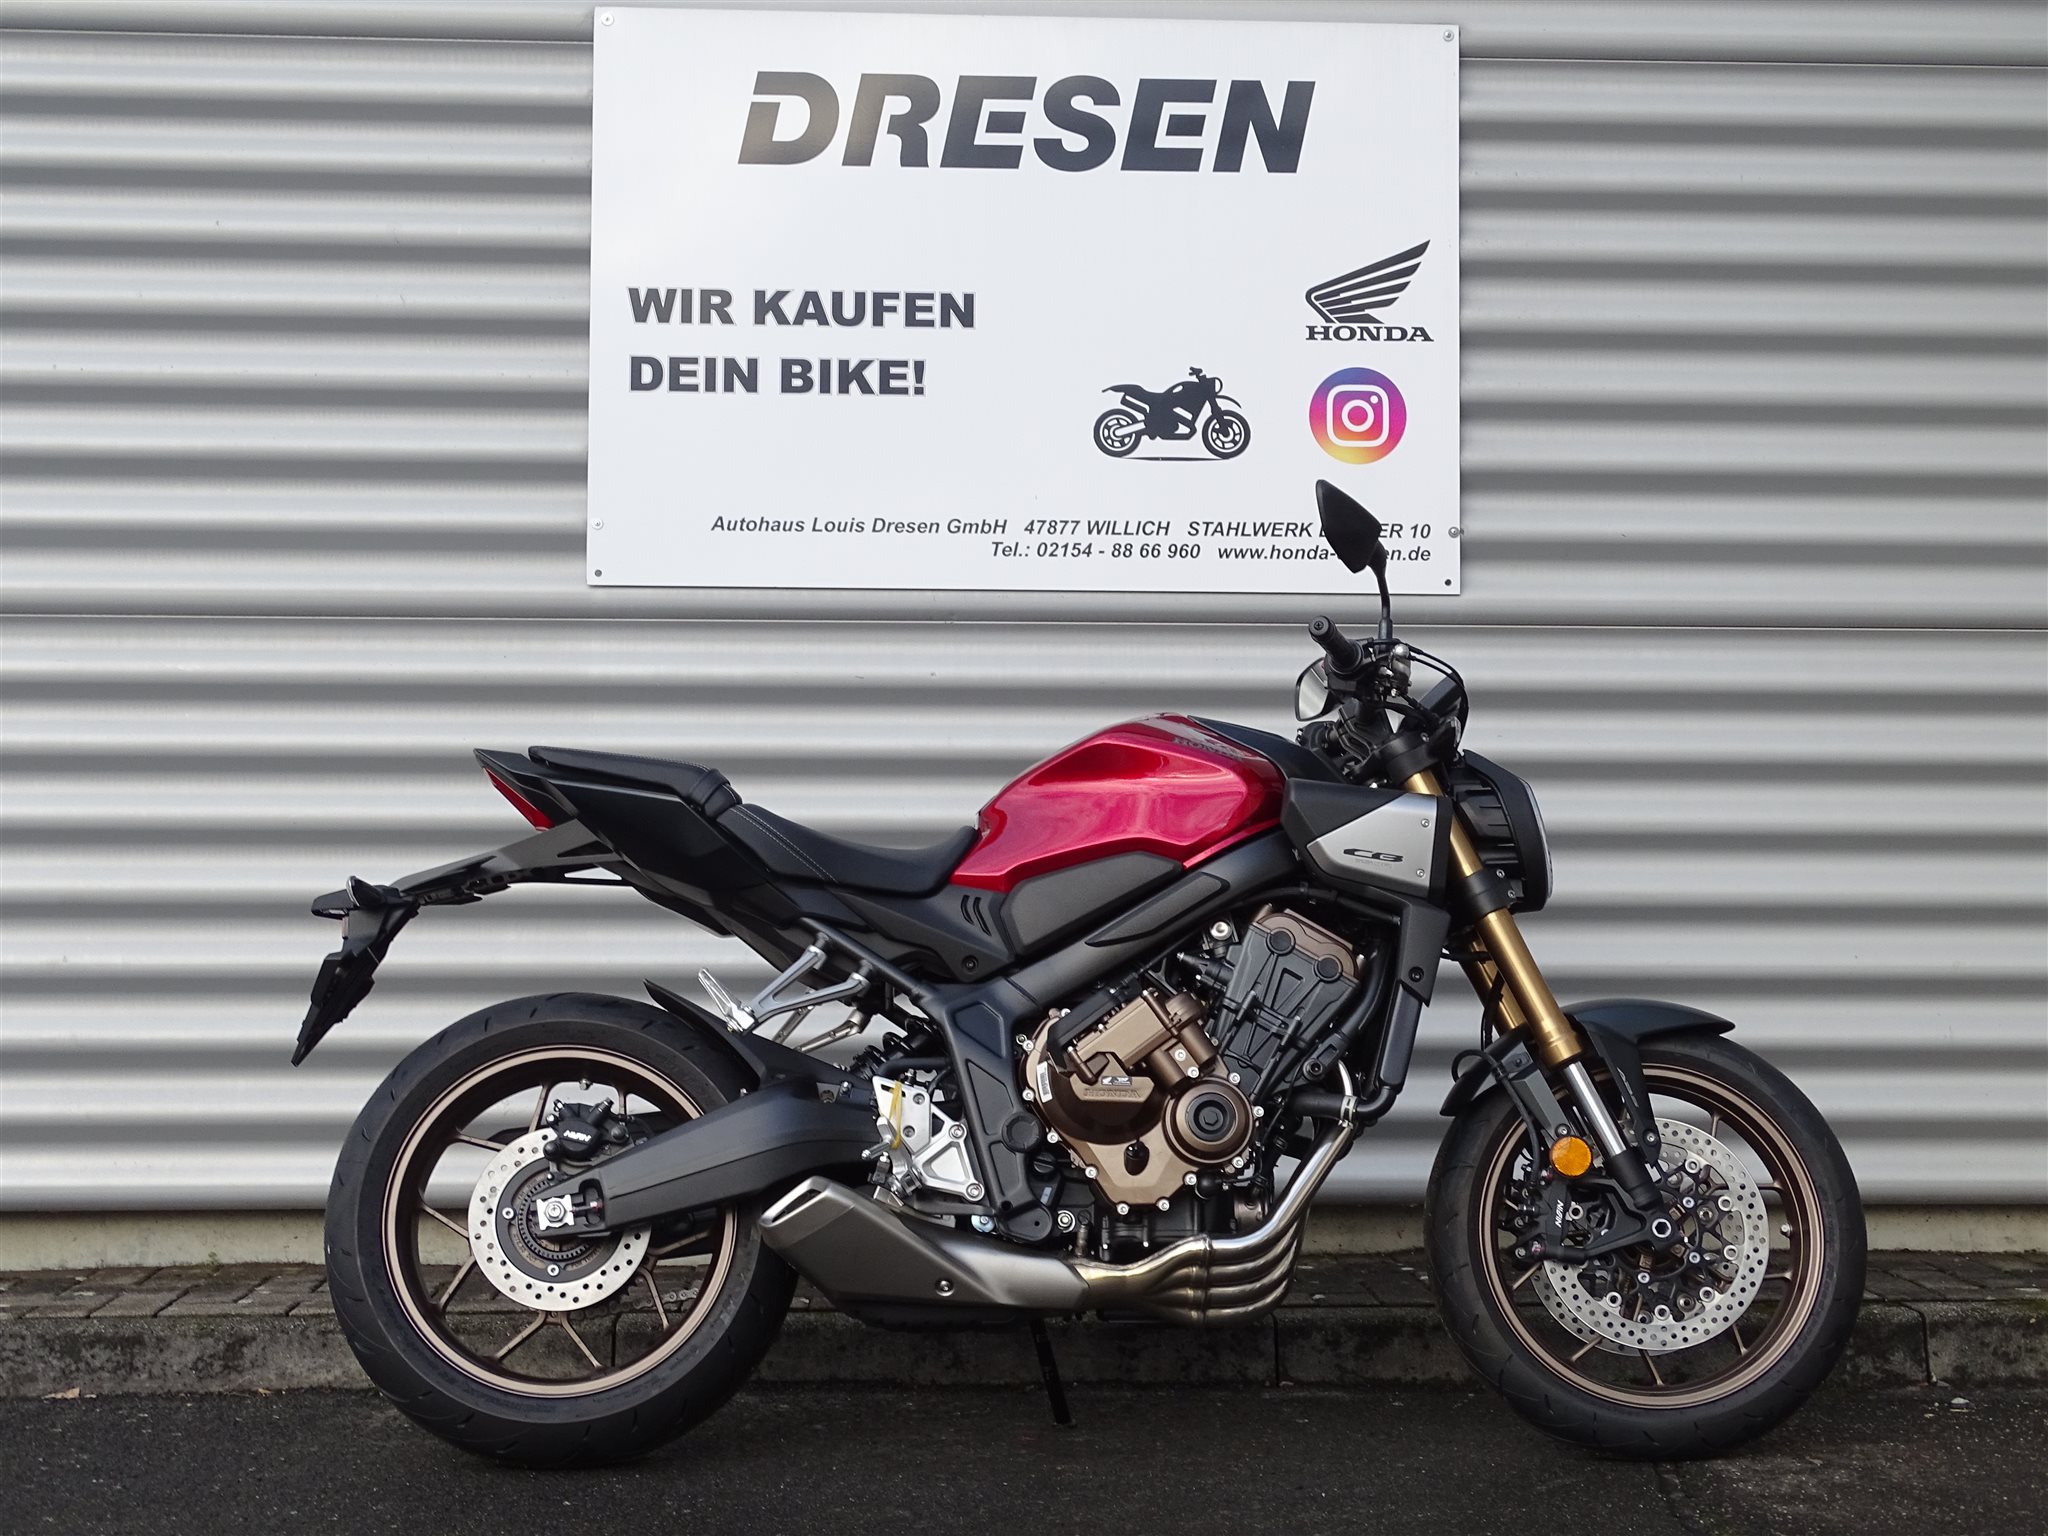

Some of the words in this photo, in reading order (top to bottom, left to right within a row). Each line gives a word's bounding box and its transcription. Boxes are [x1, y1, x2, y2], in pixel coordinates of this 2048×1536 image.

[738, 71, 1316, 174] DRESEN
[628, 287, 735, 325] WIR
[754, 290, 976, 329] KAUFEN
[1306, 324, 1434, 342] HONDA
[630, 356, 758, 393] DEIN
[780, 358, 926, 396] BIKE!
[710, 516, 805, 533] Autohaus
[811, 517, 865, 533] Louis
[871, 517, 940, 534] Dresen
[947, 518, 1008, 535] GmbH
[1023, 519, 1081, 535] 47877
[1087, 520, 1171, 536] WILLICH
[1187, 521, 1313, 538] STAHLWERK
[1410, 523, 1431, 539] 10
[991, 541, 1030, 557] Tel.:
[1036, 542, 1093, 558] 02154
[1111, 542, 1134, 559] 88
[1139, 543, 1162, 559] 66
[1167, 543, 1201, 559] 960
[1218, 544, 1431, 561] www.honda-n.de
[1084, 1088, 1142, 1099] HONDA
